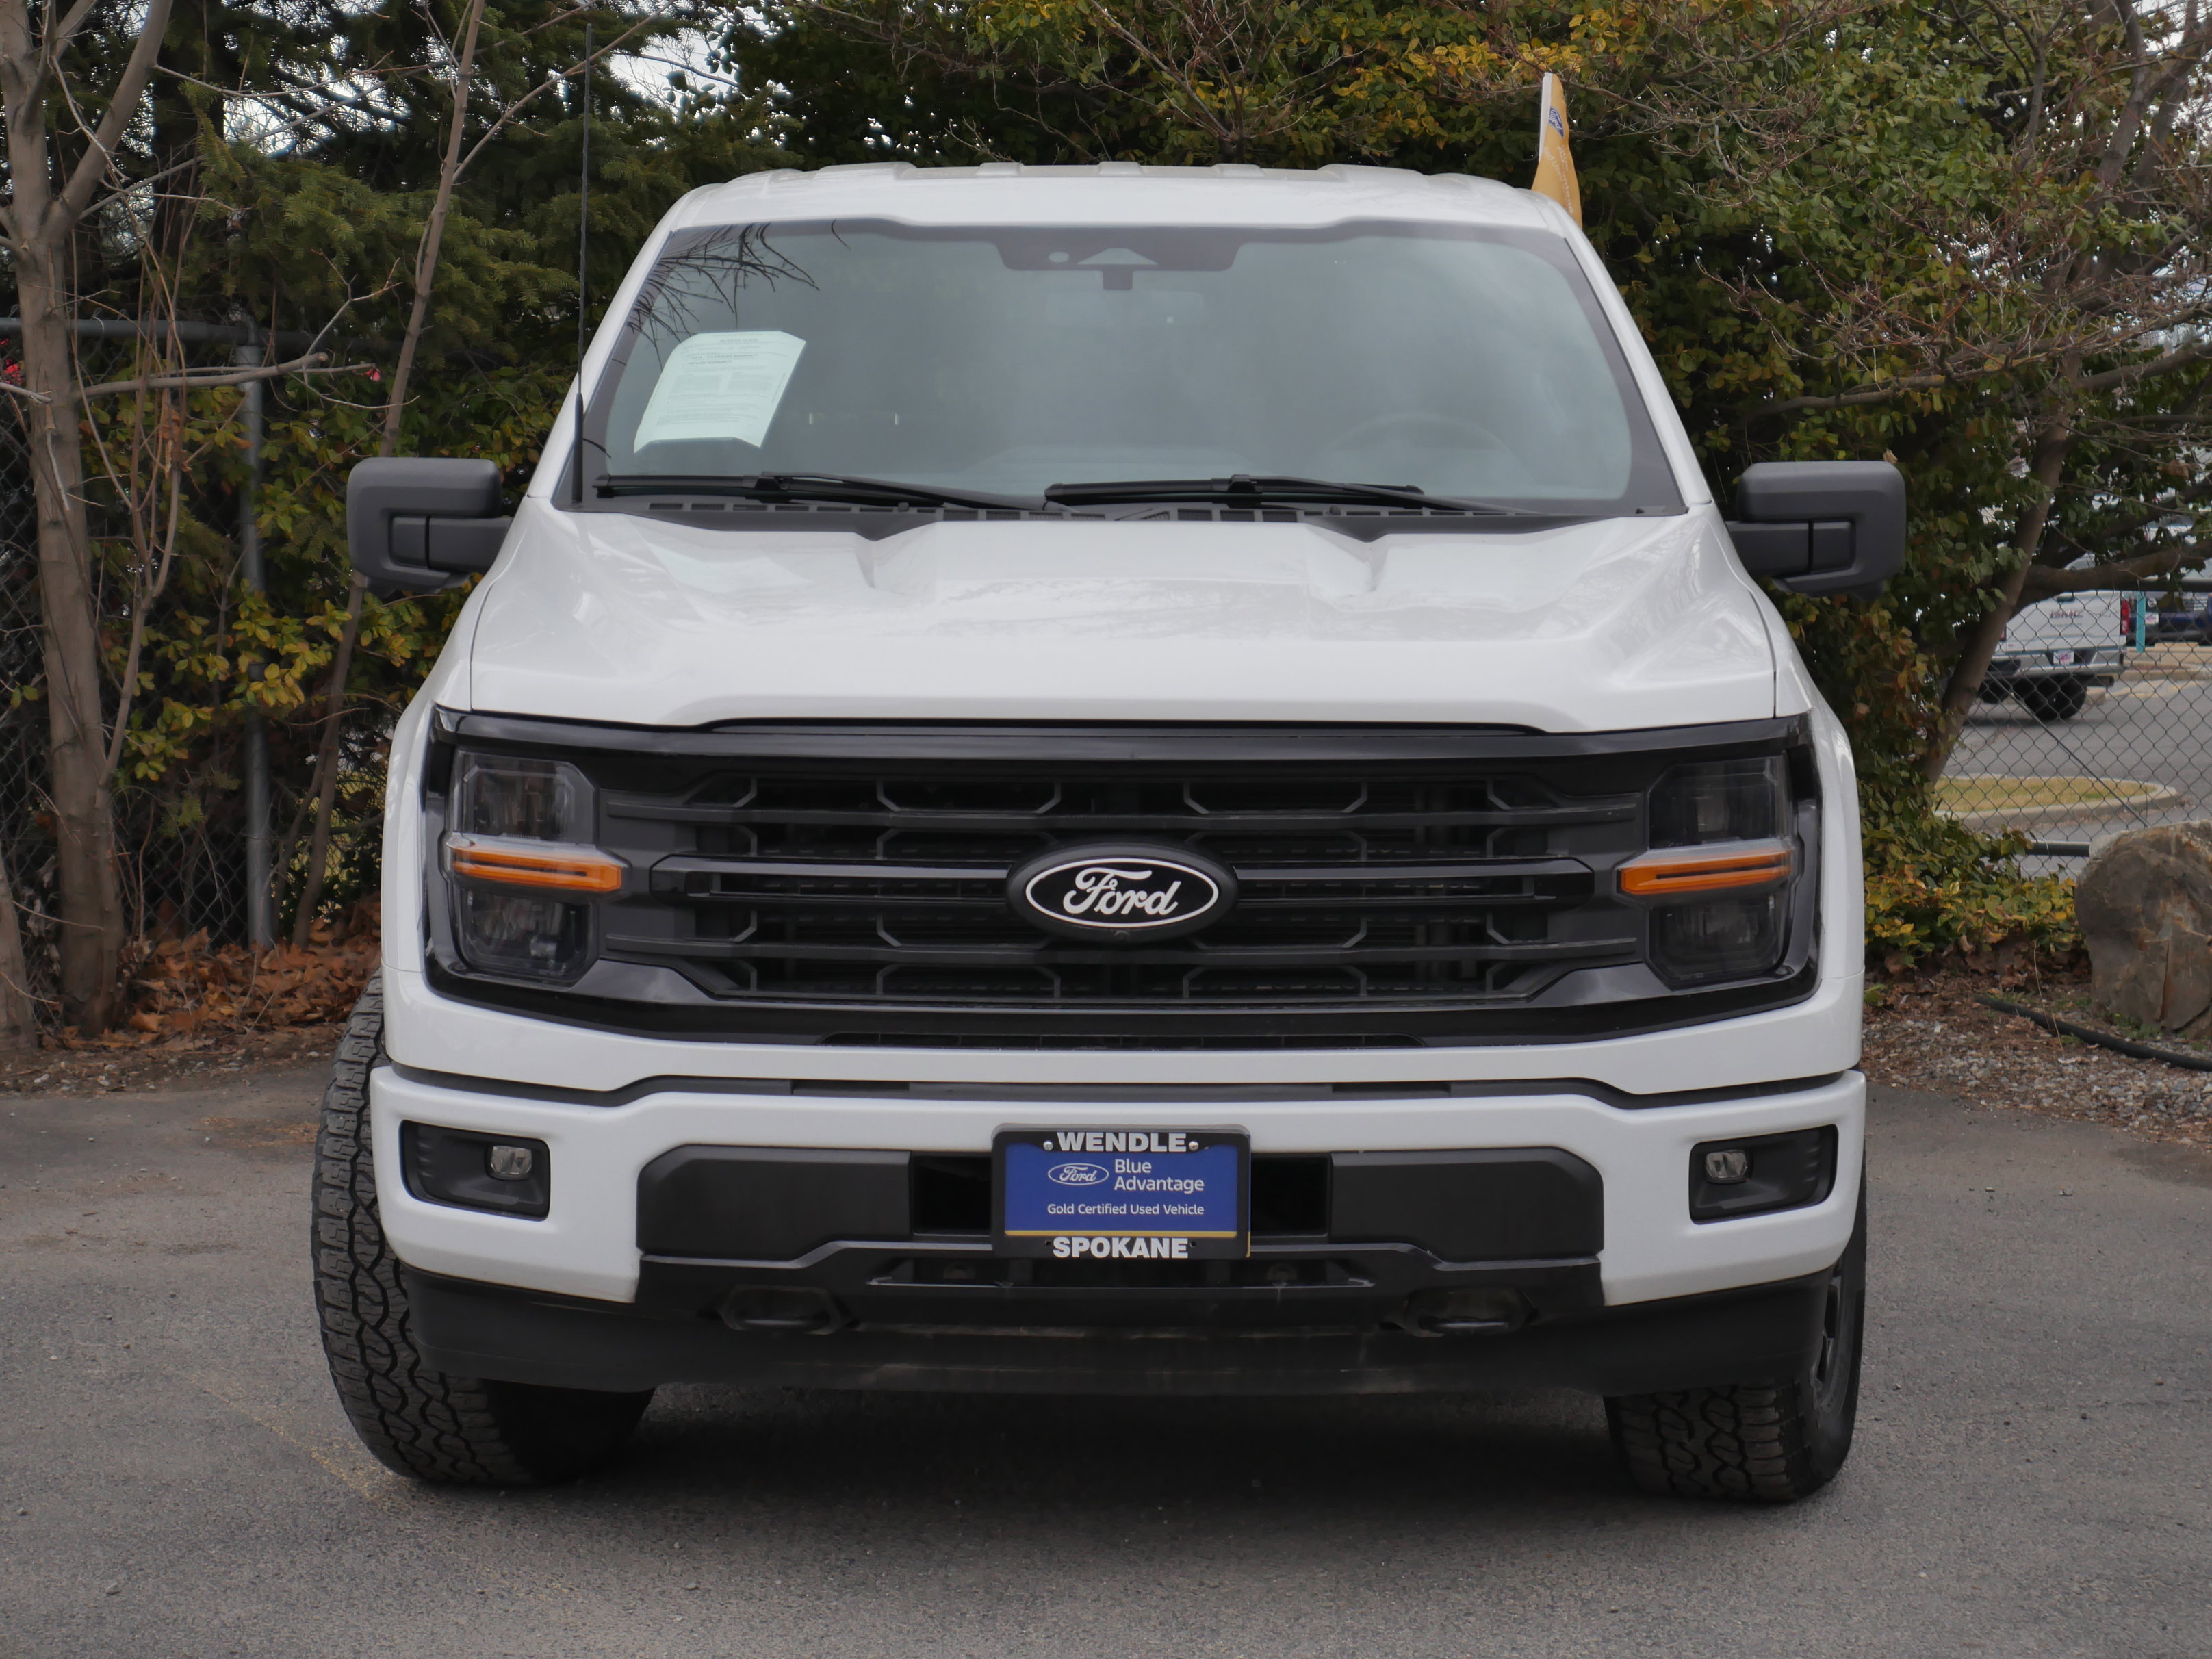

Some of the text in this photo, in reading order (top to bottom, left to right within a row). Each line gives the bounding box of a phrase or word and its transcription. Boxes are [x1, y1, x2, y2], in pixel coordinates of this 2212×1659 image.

[1063, 866, 1181, 915] Ford
[1057, 1132, 1187, 1153] WENDLE
[1059, 1166, 1097, 1183] Ford
[1114, 1158, 1152, 1174] Blue
[1114, 1176, 1205, 1194] Advantage
[1047, 1203, 1205, 1215] Gold Certified Used Vehicle
[1053, 1236, 1189, 1259] SPOKANE
